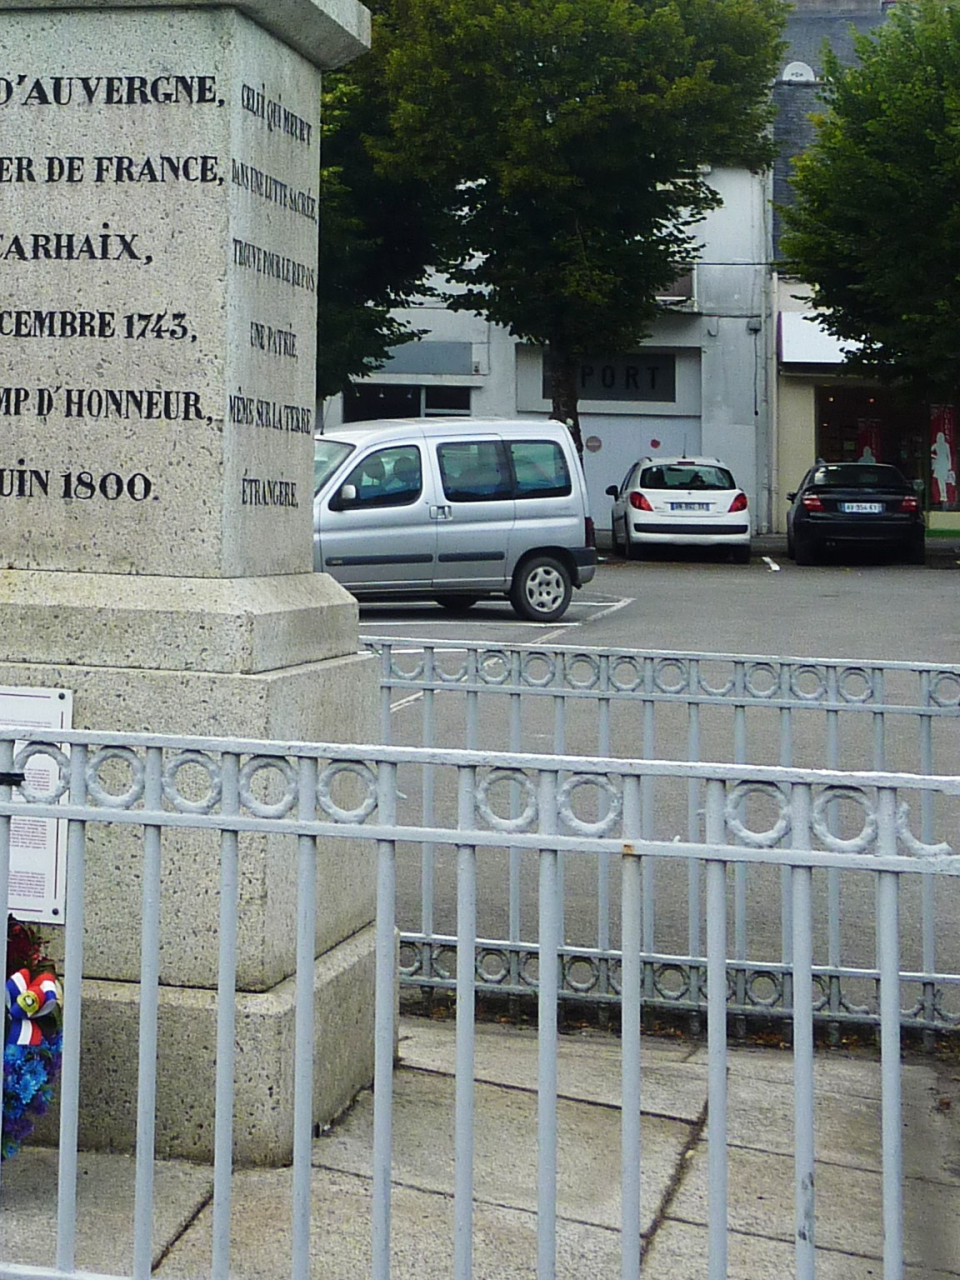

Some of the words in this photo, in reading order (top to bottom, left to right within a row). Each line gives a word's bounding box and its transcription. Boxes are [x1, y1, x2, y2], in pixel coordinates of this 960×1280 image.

[241, 83, 266, 120] CELUI
[267, 93, 282, 133] QUI
[283, 105, 313, 146] MEURT
[45, 156, 85, 183] DE
[93, 154, 225, 186] FRANCE,
[231, 158, 250, 191] DANS
[250, 167, 264, 197] UNE
[265, 175, 288, 207] LUTTE
[232, 237, 262, 273] TROUVE
[263, 250, 281, 280] POUR
[281, 257, 292, 285] LE
[292, 262, 315, 293] REPOS
[123, 310, 198, 342] 1743,
[250, 321, 265, 351] UNE
[267, 323, 299, 363] PATRIE,
[37, 384, 215, 426] D'HONNEUR,
[255, 398, 271, 428] SUR
[272, 402, 283, 430] LA
[283, 404, 312, 435] TERRE
